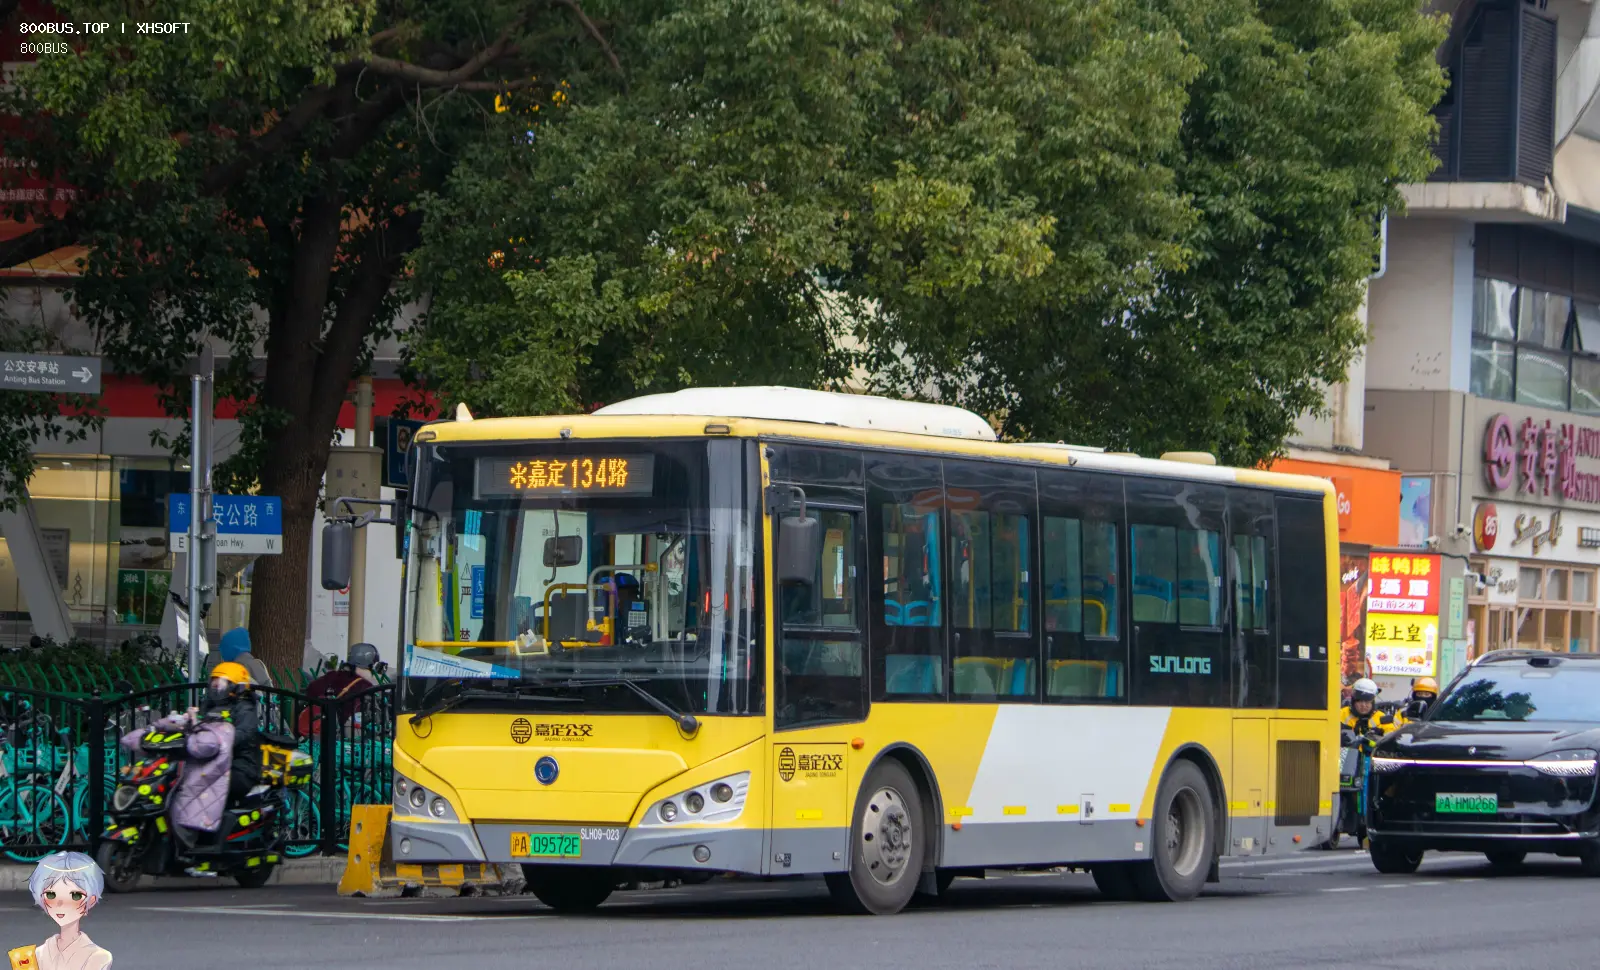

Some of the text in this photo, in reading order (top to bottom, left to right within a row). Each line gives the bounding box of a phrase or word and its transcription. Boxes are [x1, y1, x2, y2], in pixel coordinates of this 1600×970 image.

[4, 360, 59, 374] 公交安亭站
[4, 375, 66, 385] Anting Bus Station
[178, 502, 186, 515] 东
[213, 502, 258, 527] 安公路
[265, 503, 274, 516] 西
[178, 537, 185, 549] E
[216, 539, 228, 548] oan
[265, 538, 275, 550] W
[1369, 622, 1421, 642] 粒上皇
[1150, 655, 1211, 674] SUNLONG
[535, 724, 593, 737] 嘉定公交
[798, 754, 843, 771] 嘉定公交
[580, 827, 620, 841] SLH09-023
[533, 836, 580, 854] 09572F
